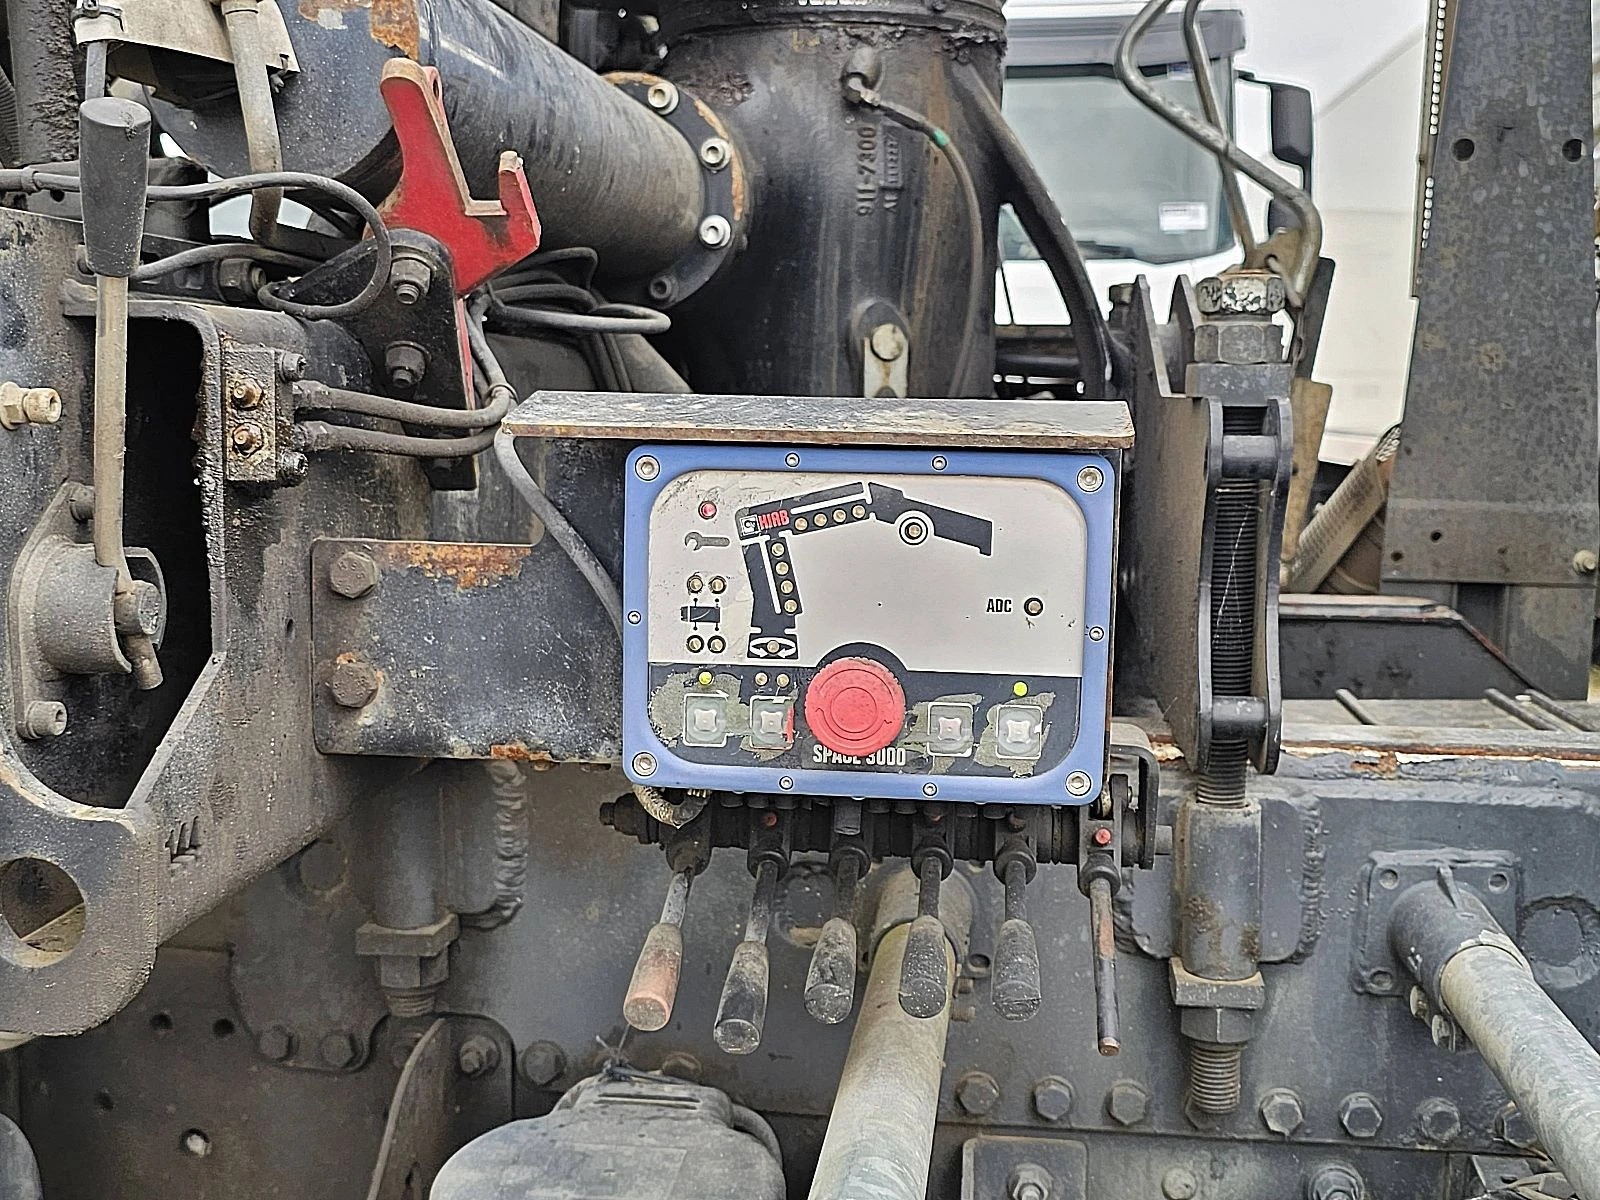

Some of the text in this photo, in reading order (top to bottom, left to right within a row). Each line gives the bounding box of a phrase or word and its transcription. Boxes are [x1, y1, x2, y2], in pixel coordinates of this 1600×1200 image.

[758, 509, 790, 530] HIAB
[986, 598, 1012, 613] ADC
[865, 746, 907, 766] 3000
